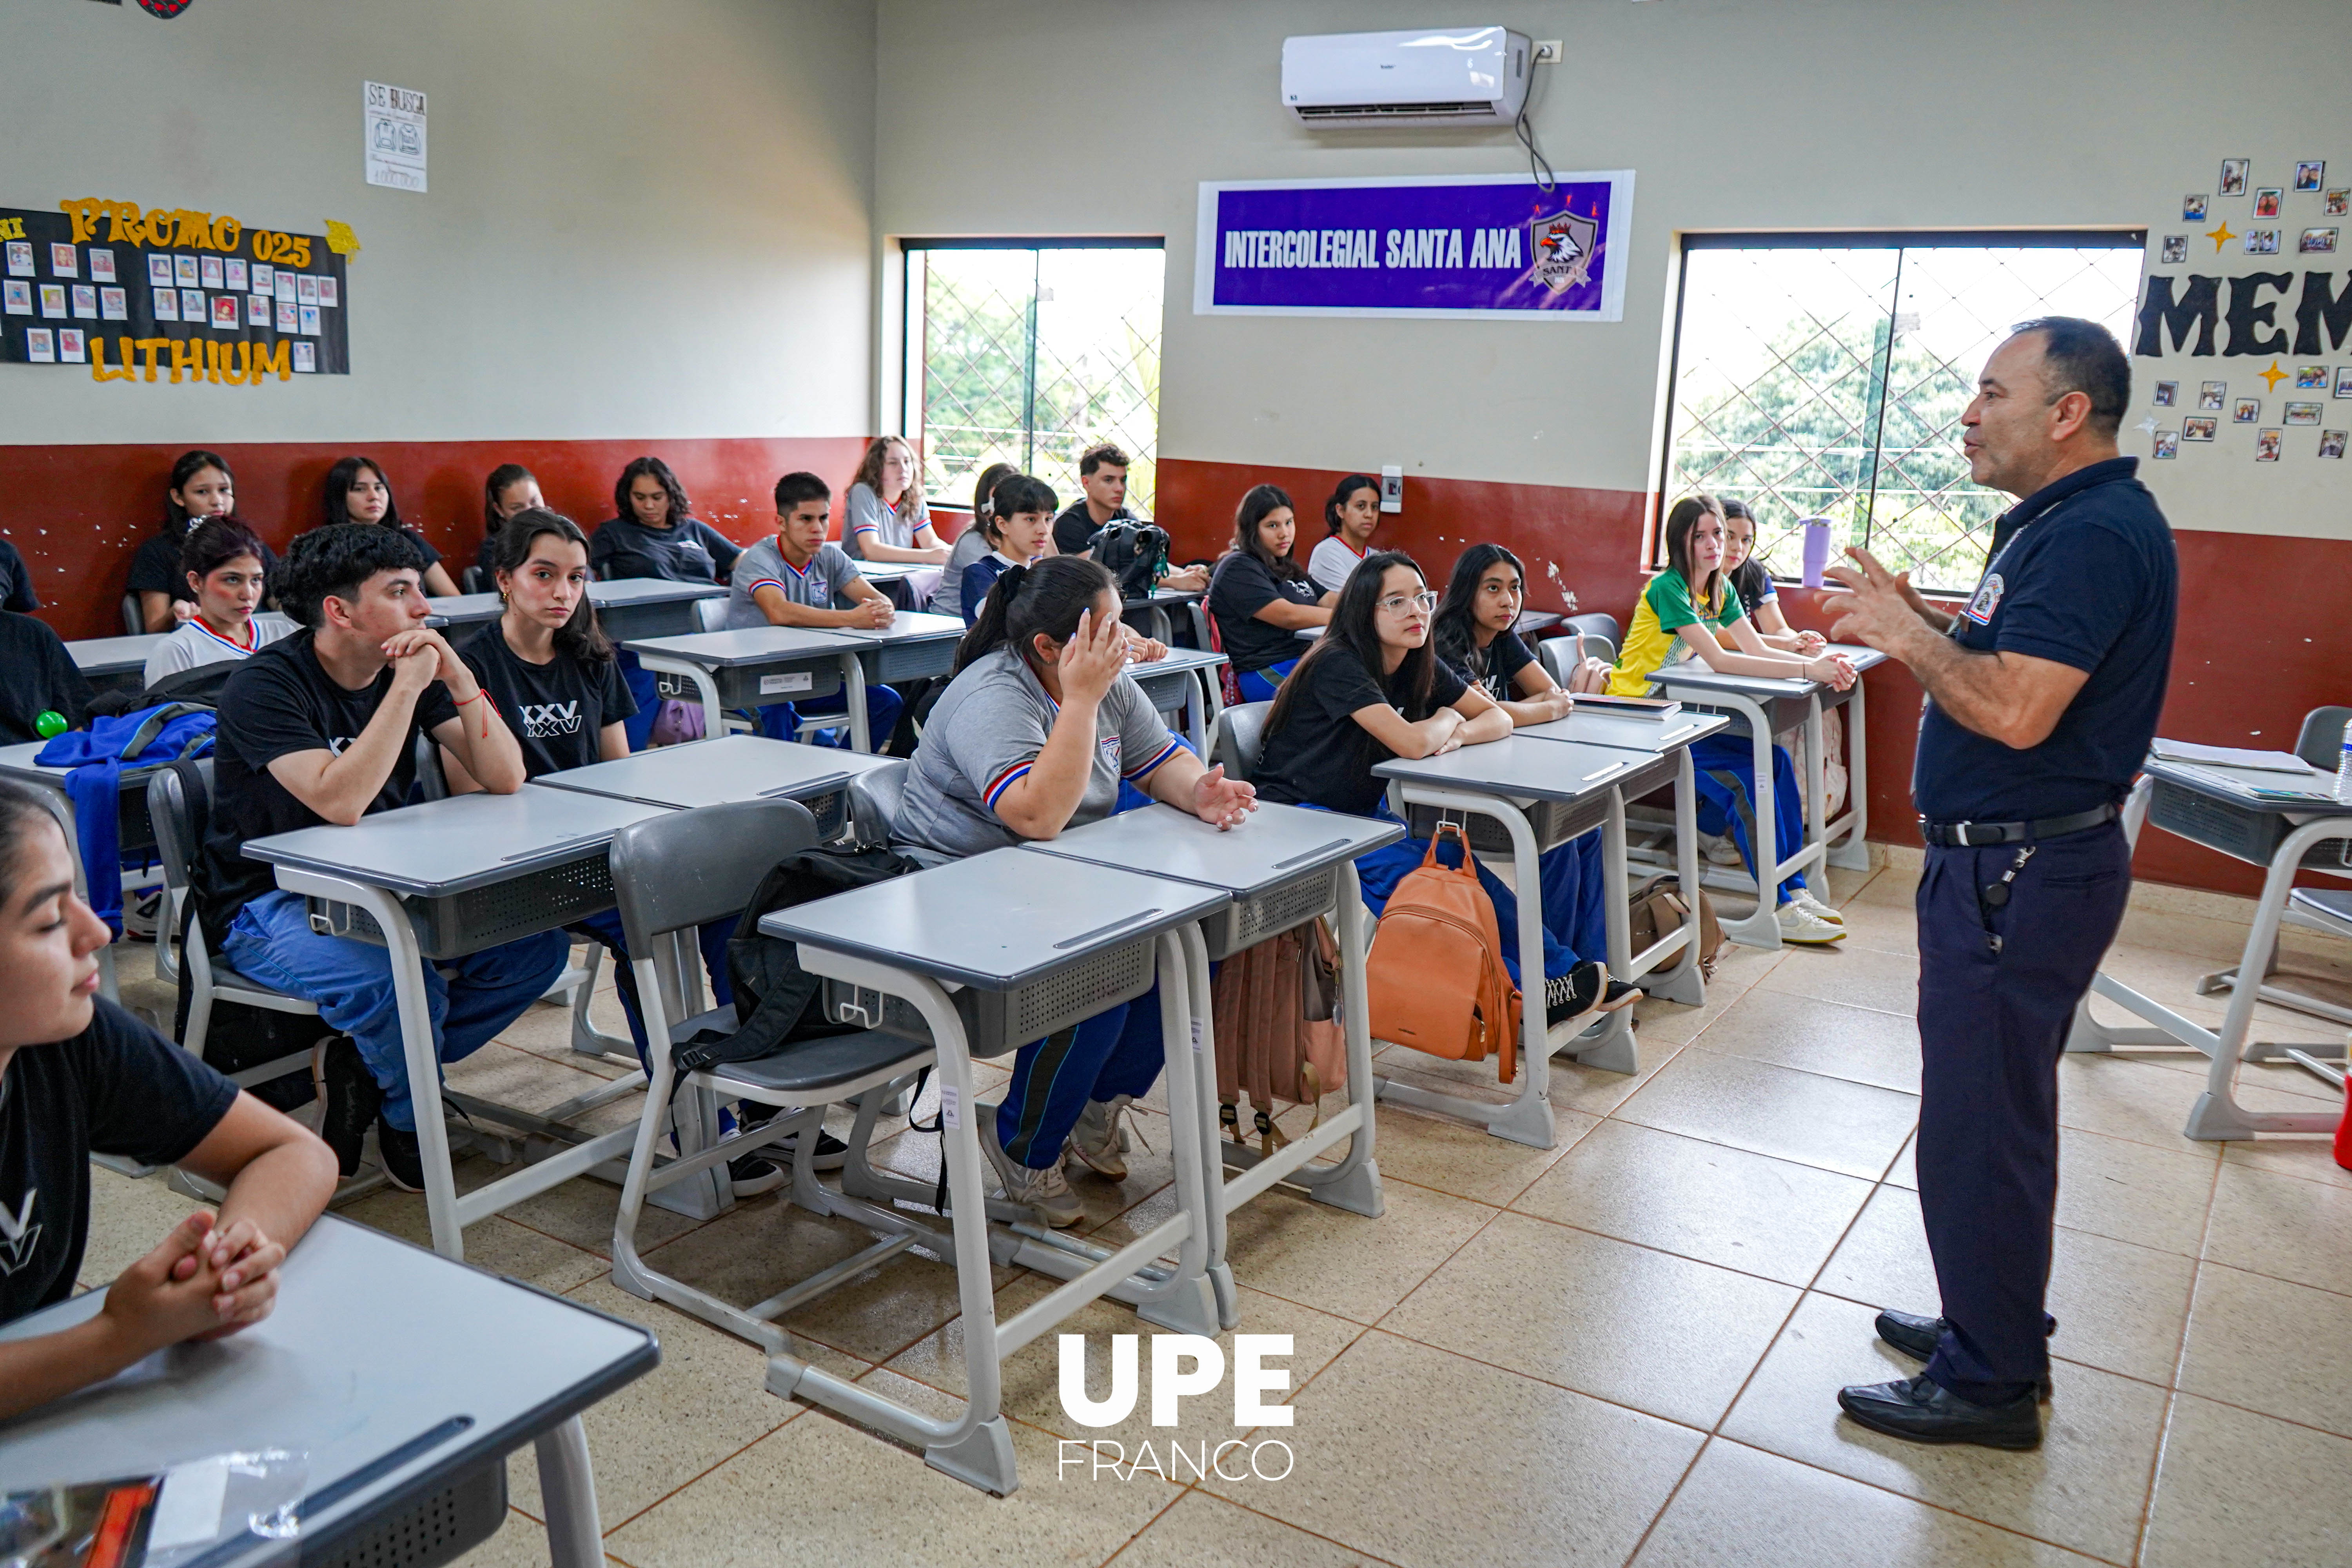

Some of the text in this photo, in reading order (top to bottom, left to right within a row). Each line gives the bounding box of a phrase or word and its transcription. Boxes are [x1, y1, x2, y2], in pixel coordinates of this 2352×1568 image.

[369, 84, 425, 116] SE BUSCA
[60, 198, 312, 268] PROMO 025
[1225, 228, 1521, 268] INTERCOLEGIAL SANTA ANA
[2136, 271, 2352, 357] MEM
[89, 336, 291, 386] LITHIUM
[519, 700, 577, 724] XXV
[525, 715, 582, 738] XXV
